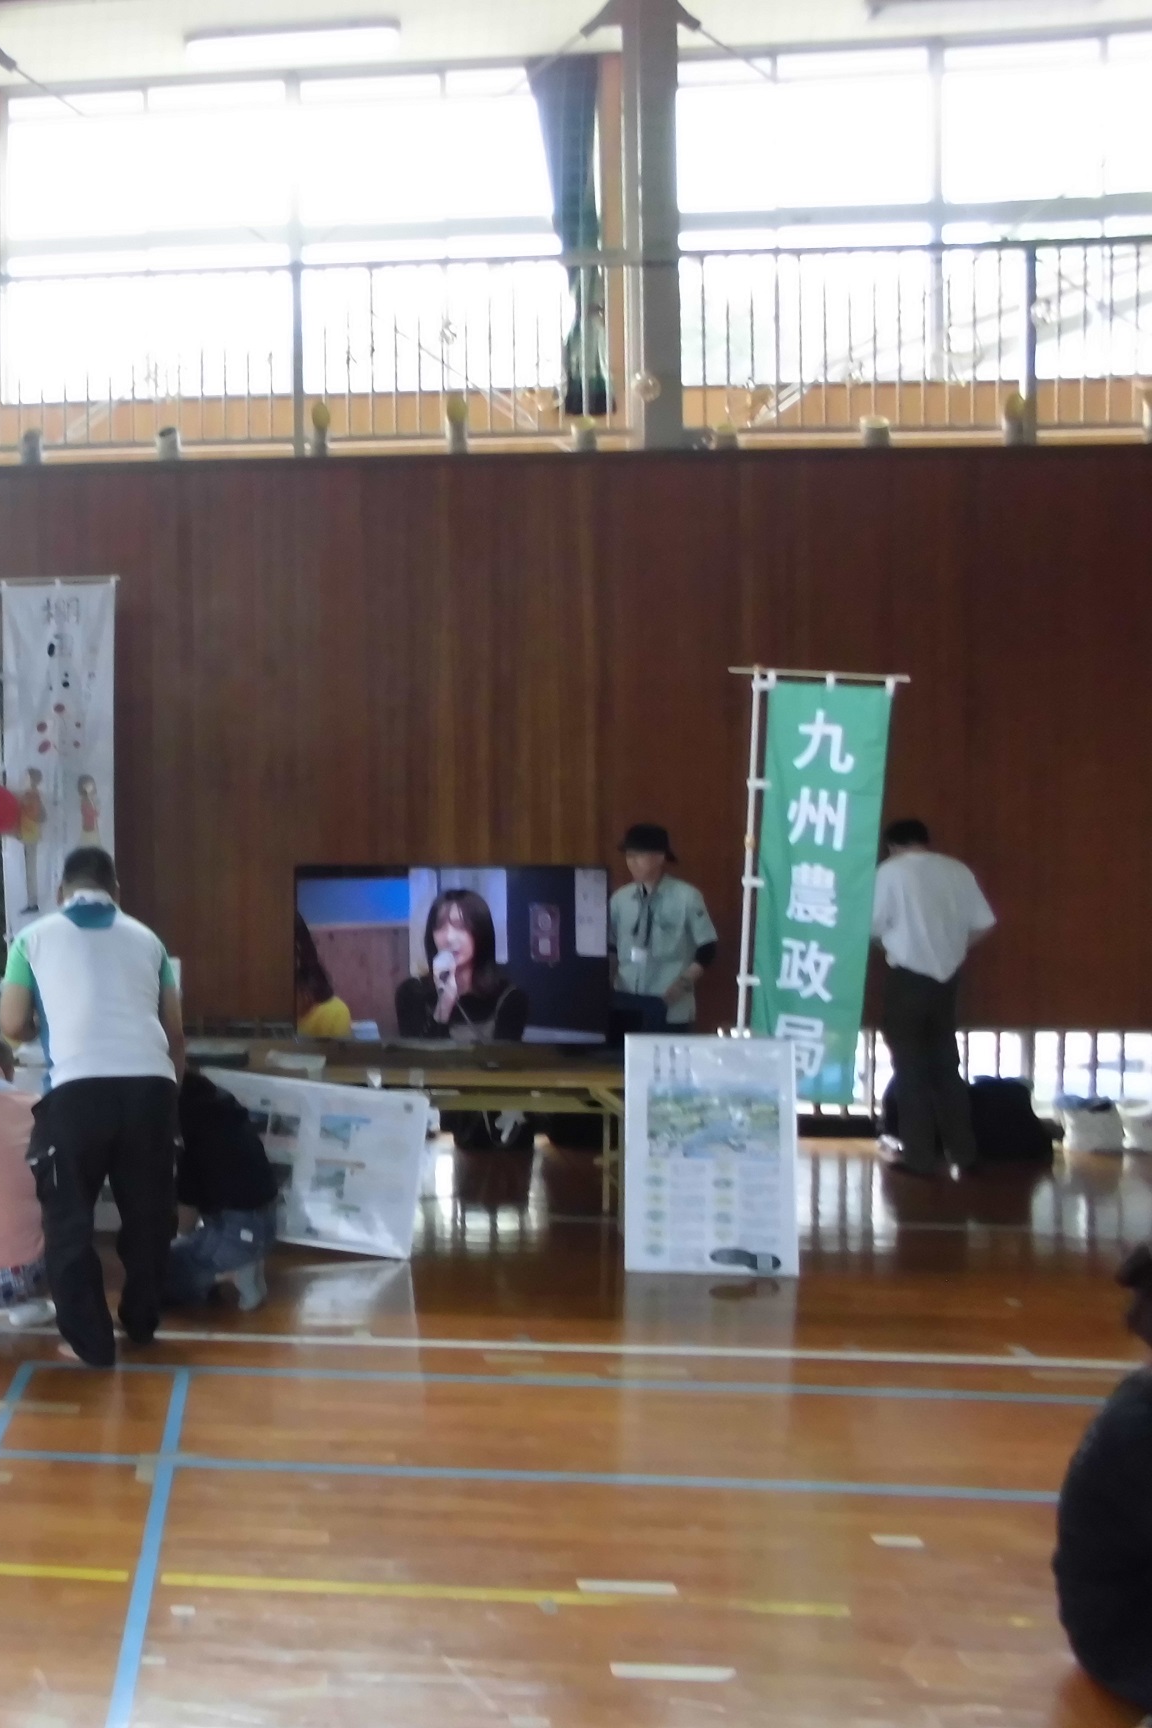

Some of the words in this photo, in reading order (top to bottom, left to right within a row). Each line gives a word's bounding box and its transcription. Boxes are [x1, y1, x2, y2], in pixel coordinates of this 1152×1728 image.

[774, 709, 855, 1079] 九州農政局
